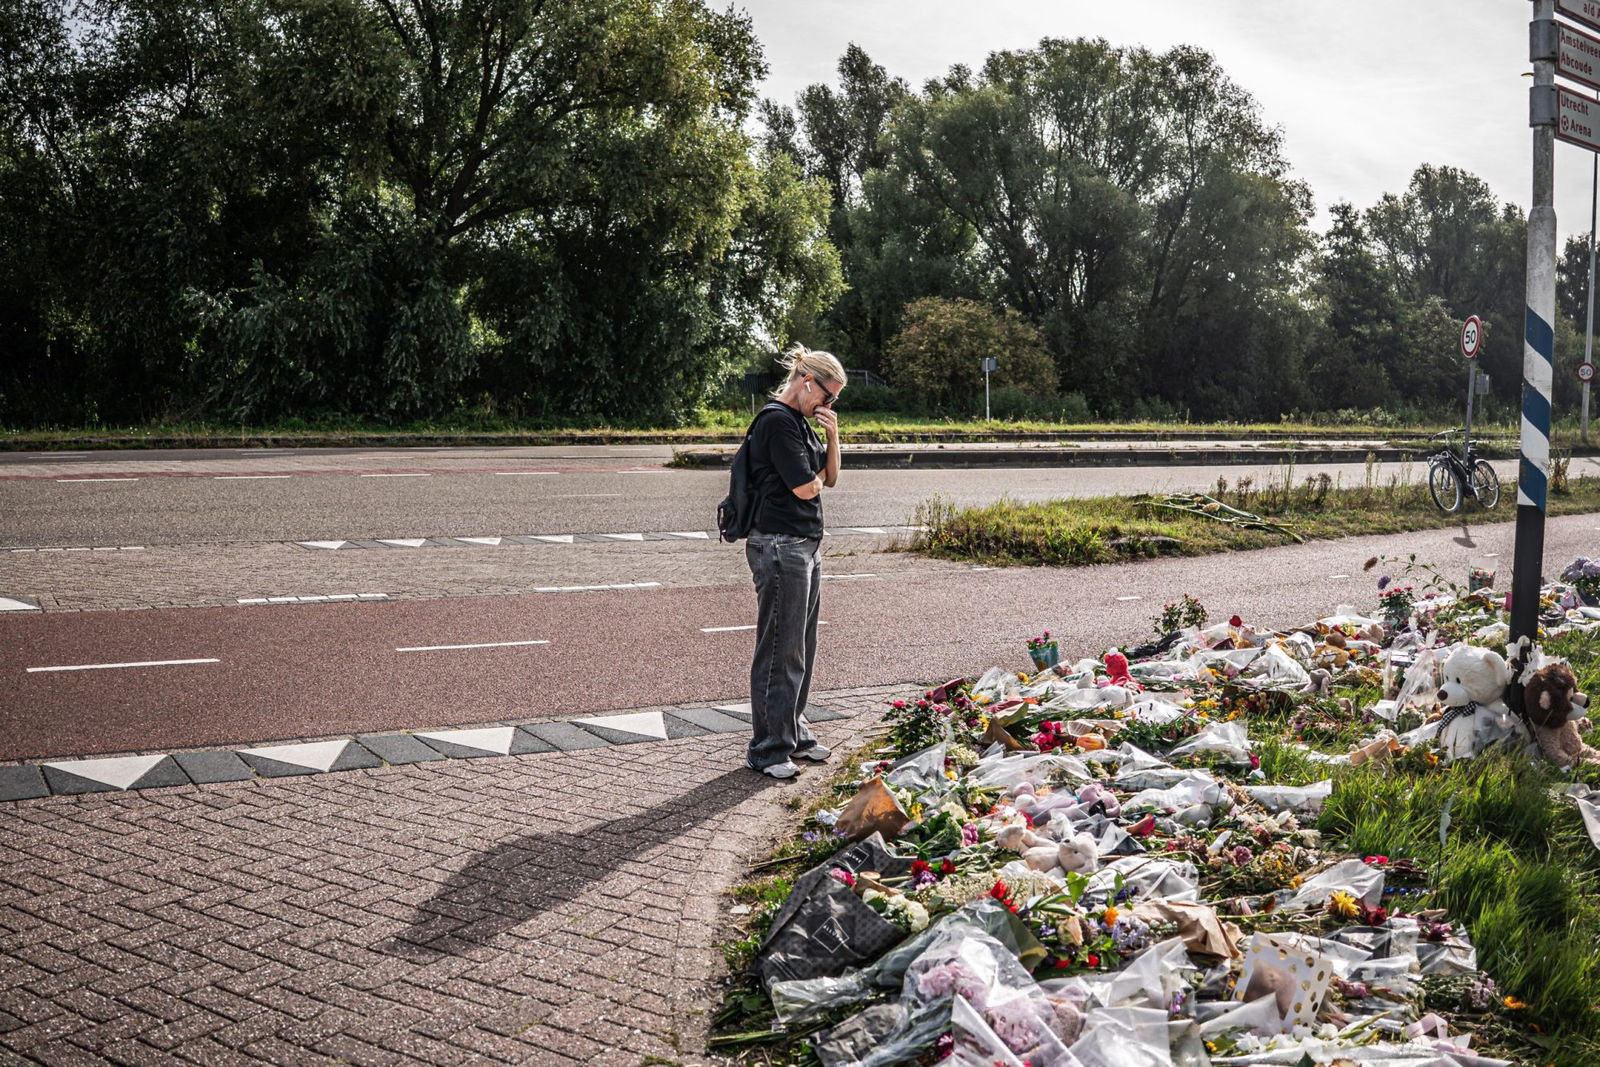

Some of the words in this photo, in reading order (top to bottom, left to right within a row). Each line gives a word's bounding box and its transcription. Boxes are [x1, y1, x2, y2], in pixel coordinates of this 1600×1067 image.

[1560, 51, 1593, 76] Abcoude
[1560, 93, 1589, 117] Utrecht
[1570, 119, 1592, 138] Arena
[1465, 330, 1477, 345] 50
[1580, 368, 1592, 377] 50
